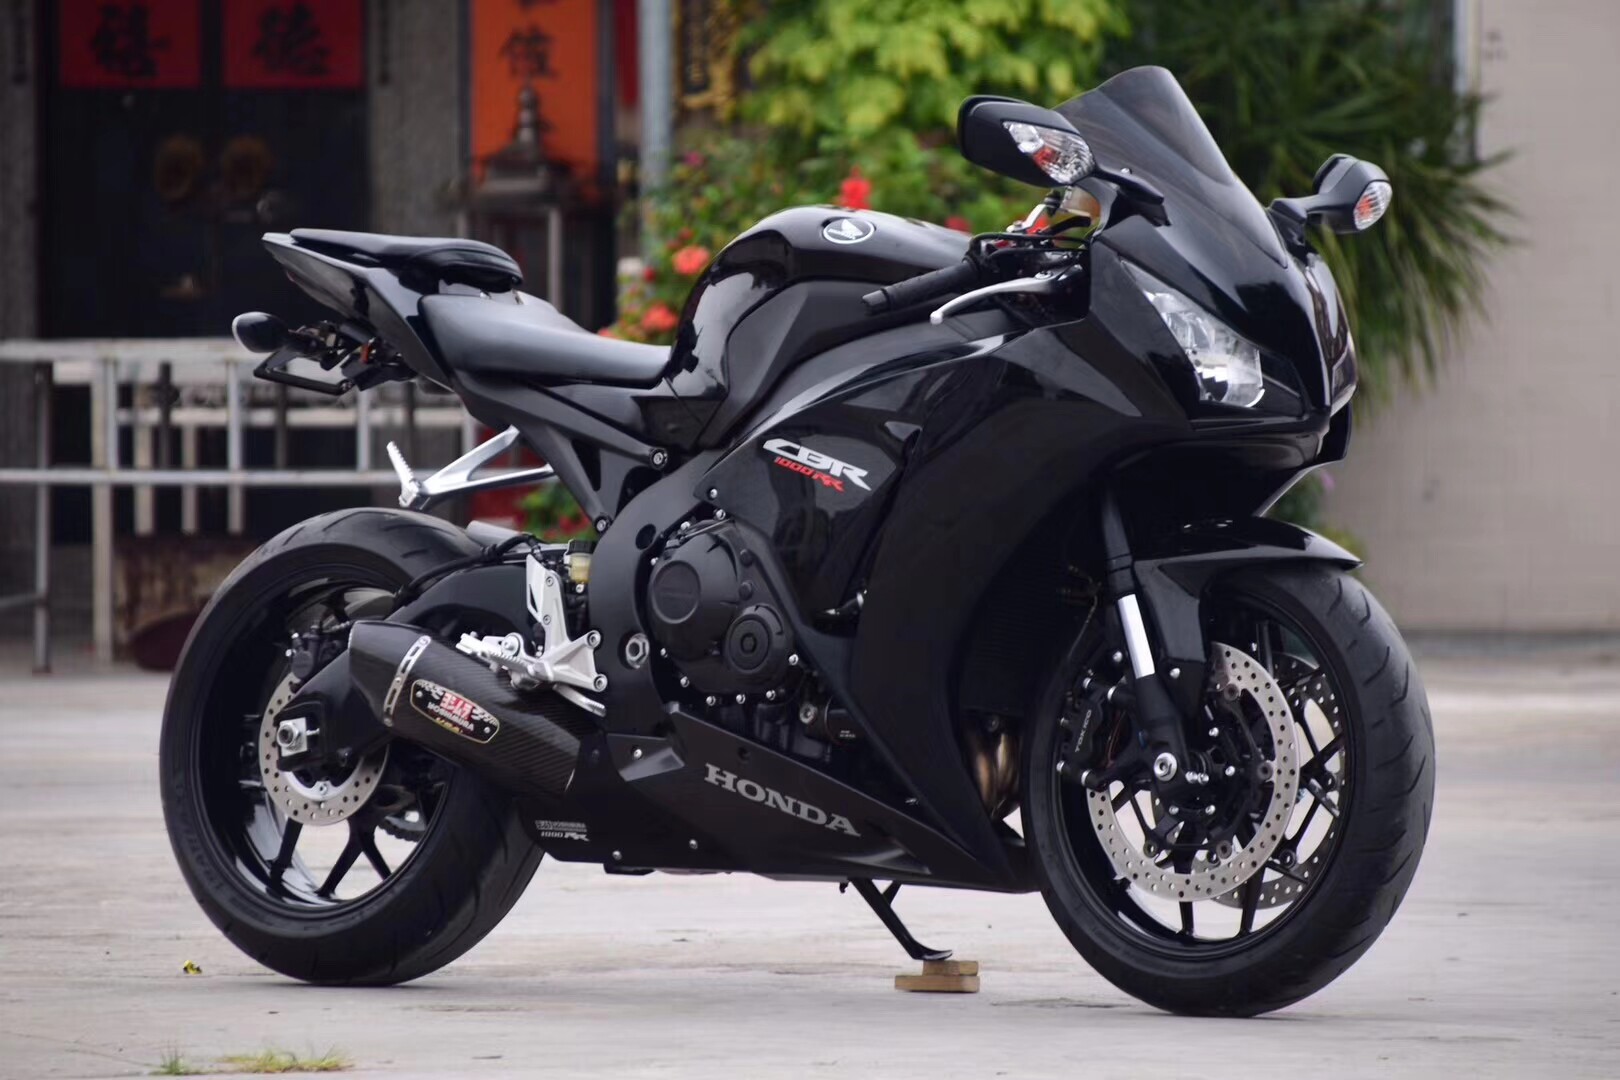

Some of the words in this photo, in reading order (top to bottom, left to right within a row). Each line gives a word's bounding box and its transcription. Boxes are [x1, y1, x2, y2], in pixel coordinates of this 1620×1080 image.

[763, 438, 872, 491] CBR
[427, 701, 475, 732] YOSHIMURA
[1074, 709, 1092, 753] TOKICO
[704, 762, 861, 837] HONDA
